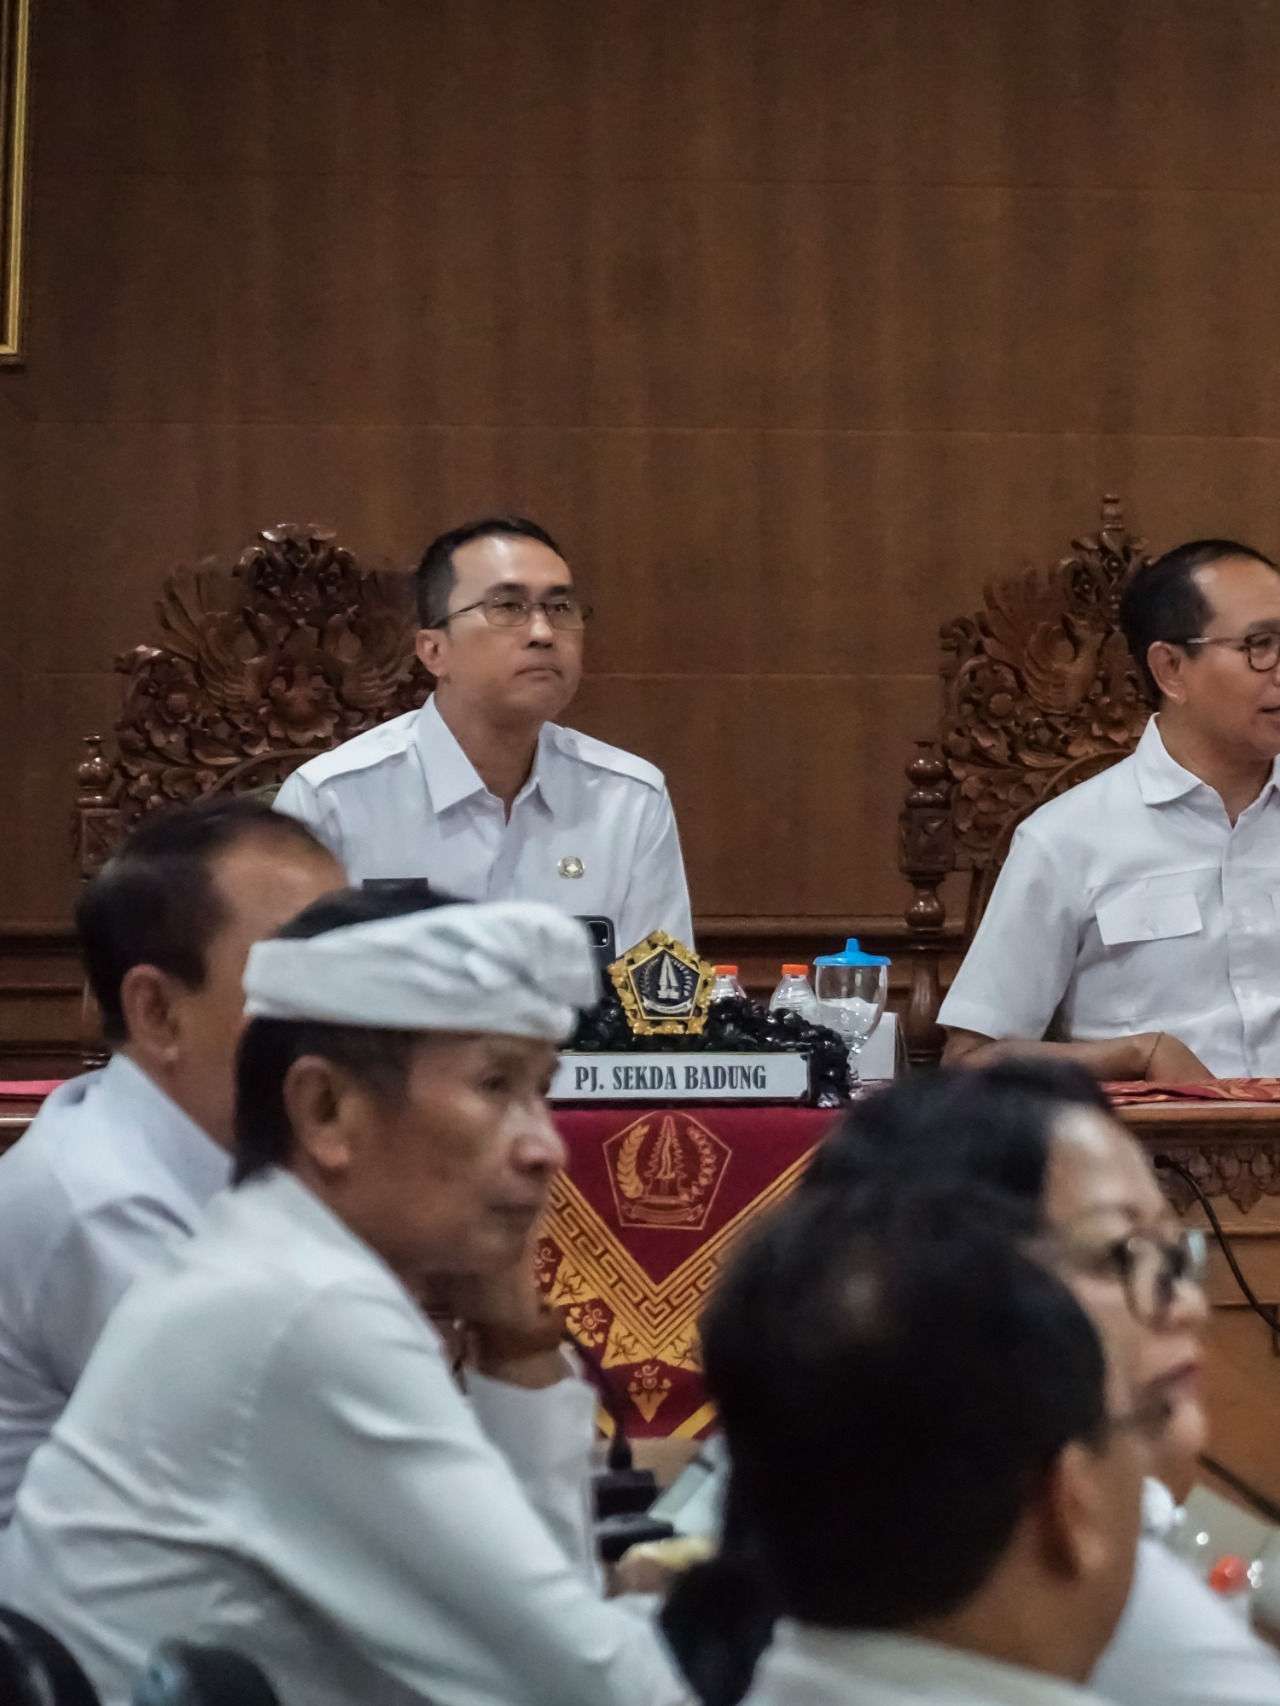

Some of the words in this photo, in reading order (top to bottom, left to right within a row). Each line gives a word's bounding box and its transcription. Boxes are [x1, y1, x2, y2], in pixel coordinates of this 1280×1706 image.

[575, 1066, 604, 1092] PJ.
[612, 1065, 677, 1090] SEKDA
[683, 1065, 767, 1090] BADUNG
